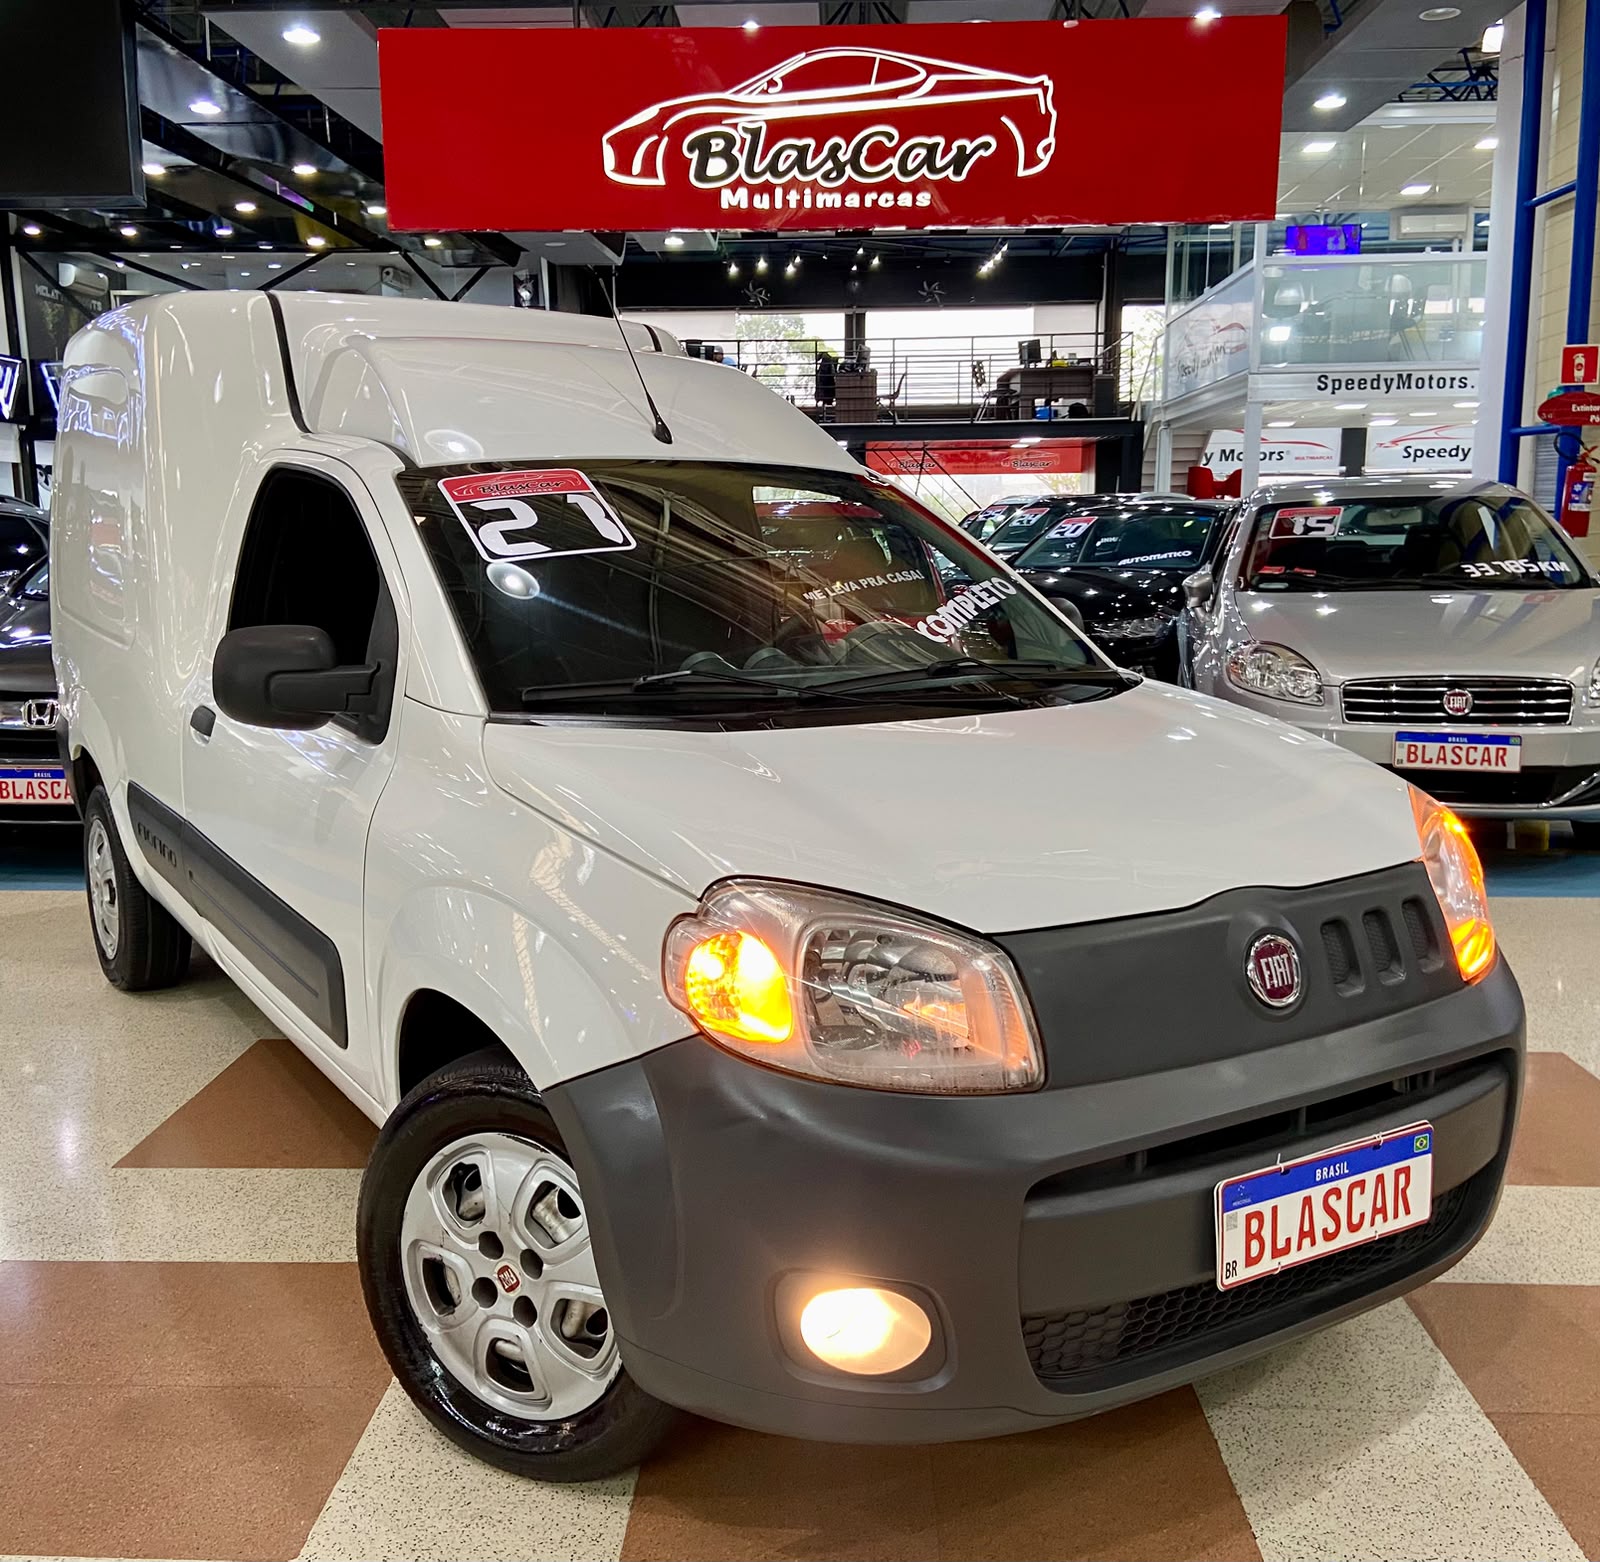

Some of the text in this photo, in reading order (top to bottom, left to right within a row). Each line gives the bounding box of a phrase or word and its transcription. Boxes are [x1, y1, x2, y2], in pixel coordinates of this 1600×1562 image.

[684, 122, 996, 189] BlasCar
[720, 187, 931, 209] Multimarcas
[1219, 449, 1285, 462] Moors
[1402, 445, 1471, 462] Speedy
[478, 480, 565, 494] BlasCar
[470, 494, 624, 556] 21
[1049, 523, 1088, 538] 20
[803, 569, 926, 601] ME LEVA PRA CASA!
[917, 577, 1017, 643] COMPLETO
[1448, 696, 1467, 708] FIAT
[1406, 743, 1508, 767] BLASCAR
[1260, 953, 1292, 990] FIAT
[1315, 1161, 1350, 1182] BRASIL
[1244, 1165, 1411, 1269] BLASCAR
[1225, 1260, 1238, 1280] BR
